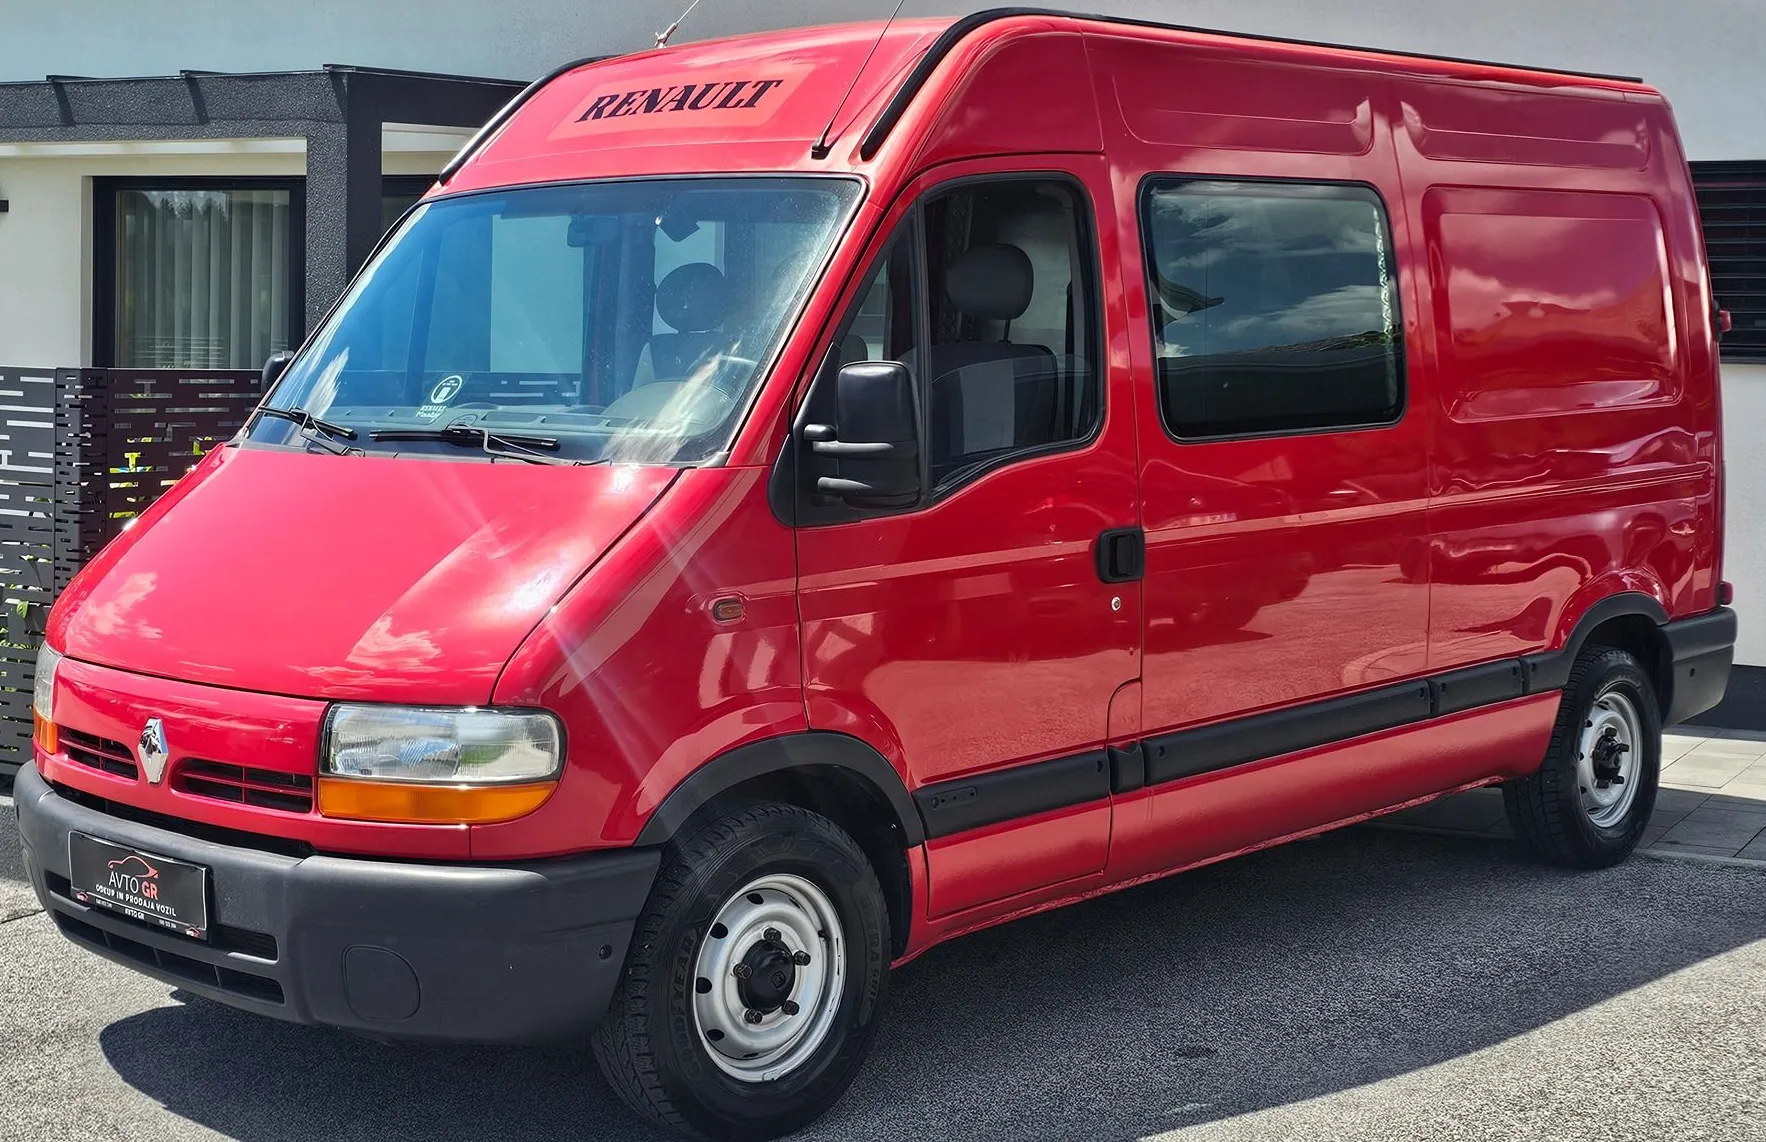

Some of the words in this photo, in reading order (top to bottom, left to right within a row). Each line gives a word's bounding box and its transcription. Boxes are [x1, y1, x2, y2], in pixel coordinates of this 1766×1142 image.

[574, 79, 783, 123] RENAULT
[109, 871, 139, 894] AVTO
[141, 881, 159, 900] GR
[116, 891, 124, 900] IN
[125, 894, 155, 910] PRODAJA
[156, 904, 177, 917] VOZIL
